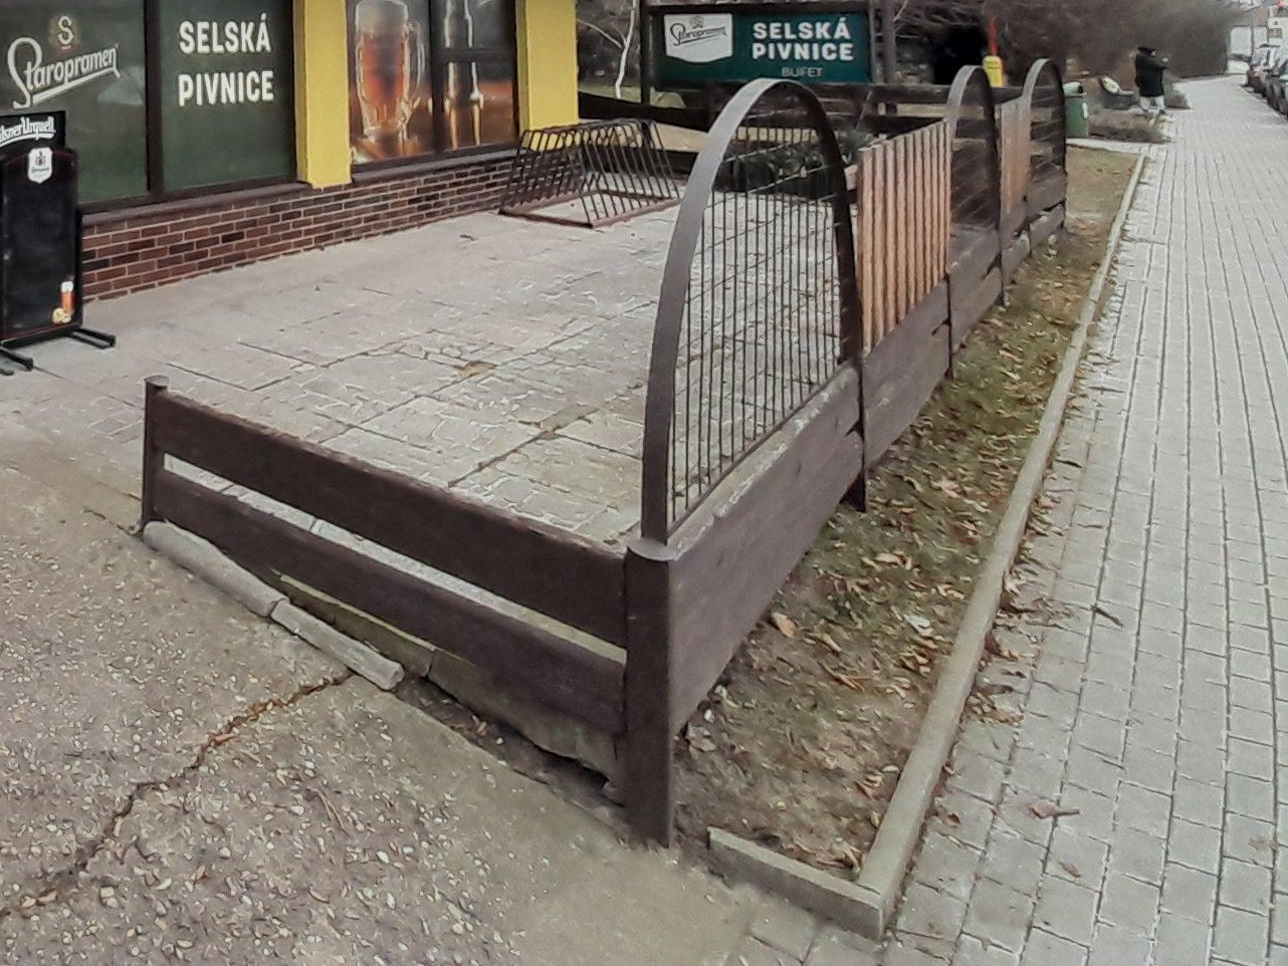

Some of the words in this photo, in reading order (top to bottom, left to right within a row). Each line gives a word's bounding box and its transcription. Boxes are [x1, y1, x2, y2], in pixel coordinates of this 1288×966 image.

[179, 13, 272, 54] SELSKÁ
[753, 17, 851, 39] SELSKÁ
[752, 43, 854, 61] PIVNICE
[7, 37, 120, 109] Staropramen
[781, 67, 824, 77] BUFET
[178, 70, 274, 107] PIVNICE
[21, 117, 56, 140] Urquell
